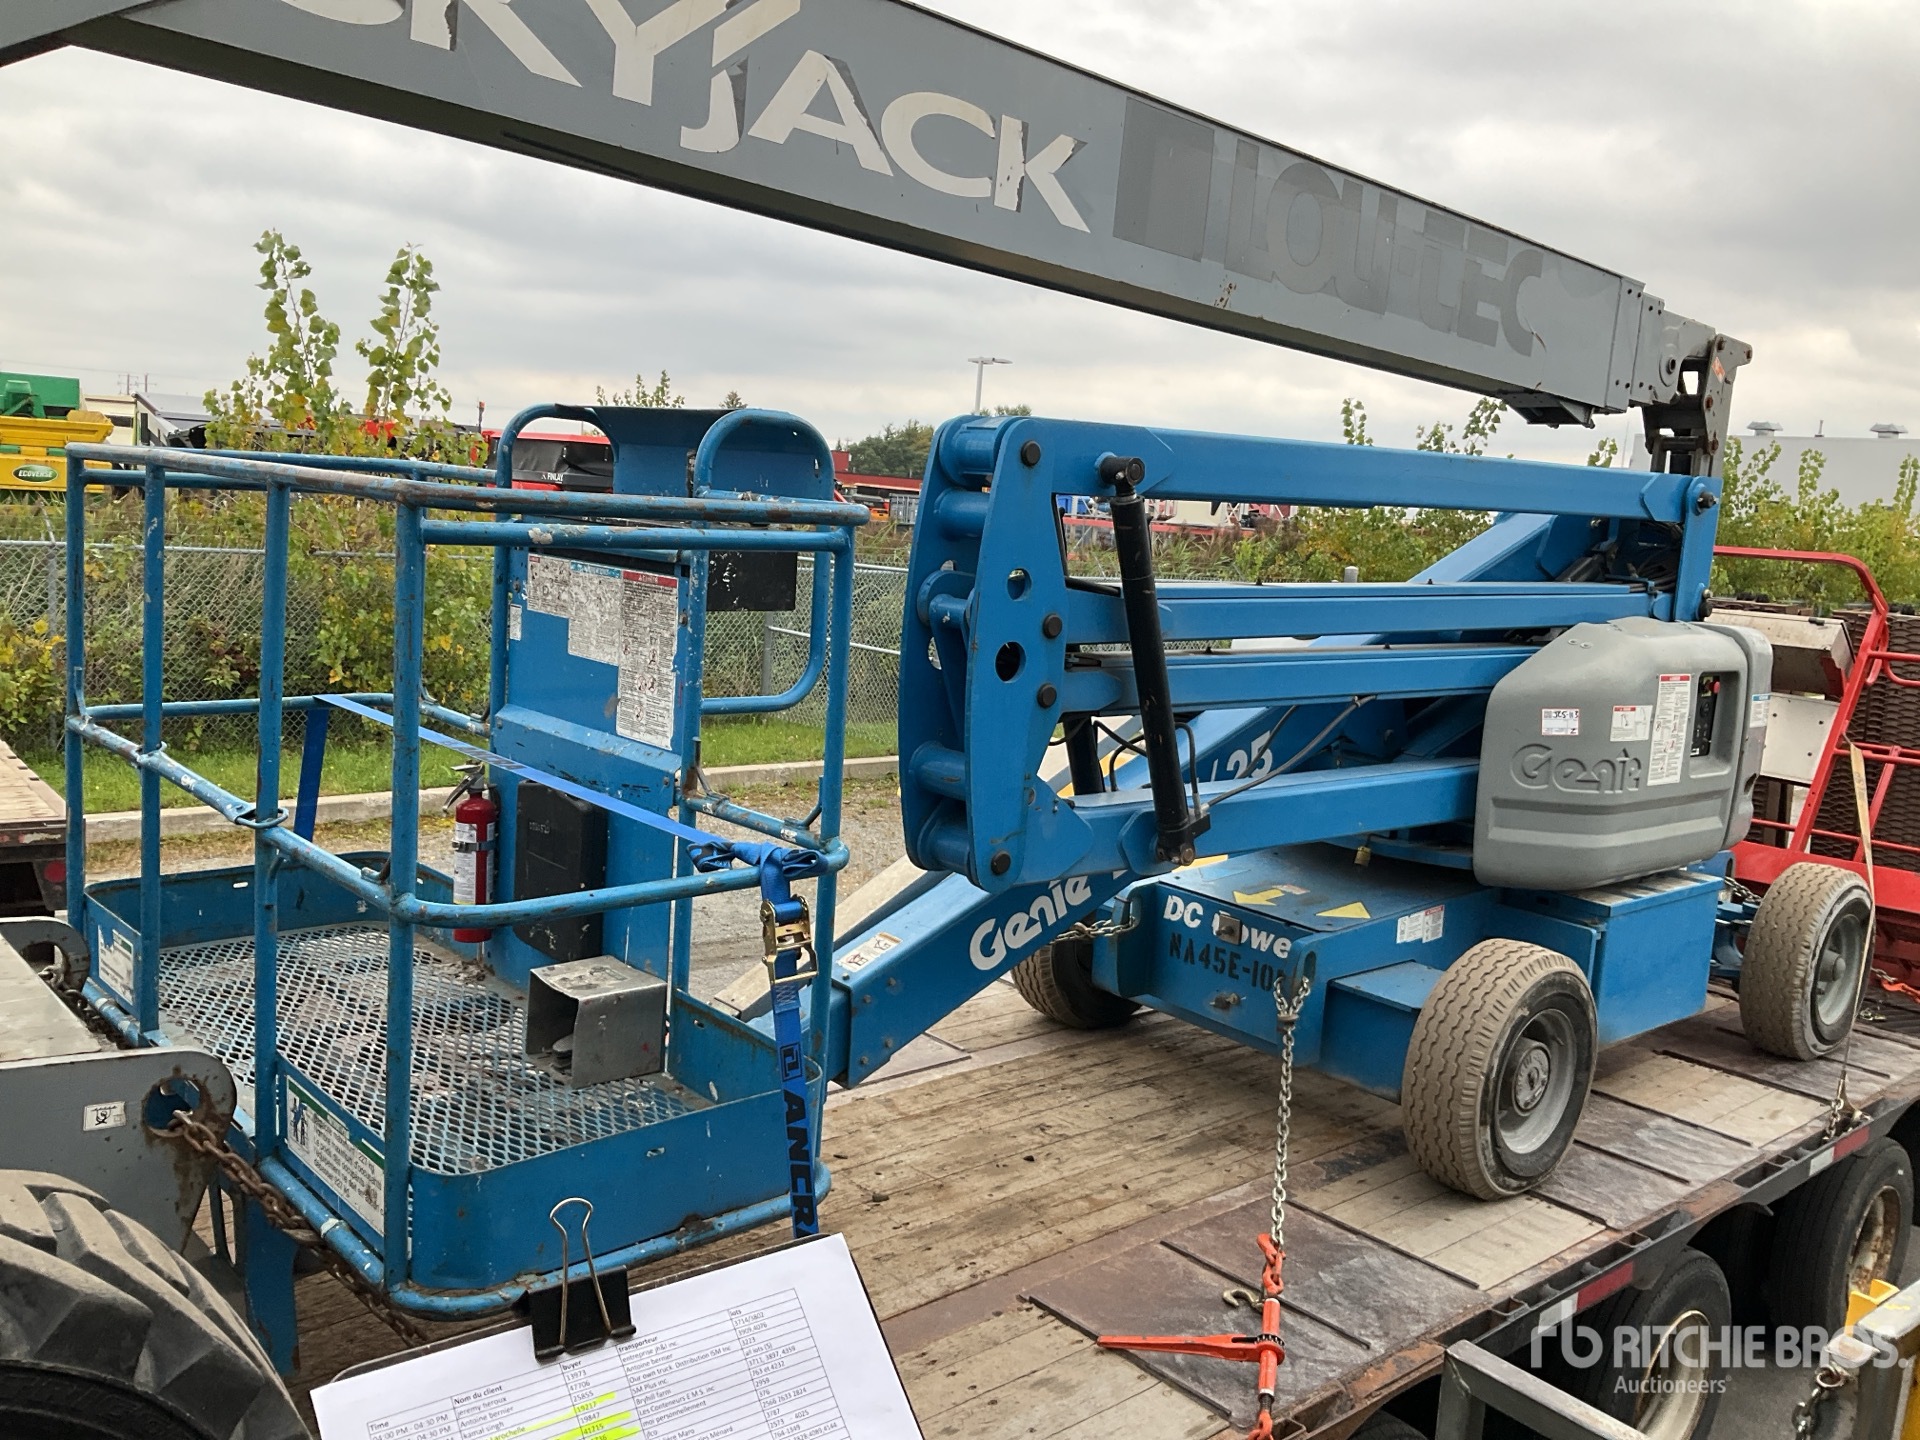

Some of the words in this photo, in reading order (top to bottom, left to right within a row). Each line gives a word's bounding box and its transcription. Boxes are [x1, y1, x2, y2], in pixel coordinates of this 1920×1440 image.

[18, 469, 53, 478] ECOVERSE
[547, 472, 564, 482] FINLAY
[1510, 743, 1644, 794] Genie
[1163, 895, 1204, 929] DC
[969, 875, 1092, 971] Genie
[618, 1337, 657, 1352] transporteur
[742, 1336, 755, 1345] 3223
[621, 1347, 653, 1362] entreprise
[562, 1359, 582, 1370] buyer
[625, 1360, 649, 1372] Antoine
[650, 1353, 672, 1364] bernier
[628, 1374, 640, 1383] Our
[642, 1370, 655, 1379] own
[674, 1352, 709, 1368] Distribution
[566, 1369, 586, 1380] 13973
[755, 1377, 769, 1387] 2959
[569, 1379, 590, 1391] 47706
[644, 1382, 656, 1390] Plus
[453, 1395, 471, 1405] Nom
[472, 1390, 482, 1399] du
[482, 1384, 502, 1396] client
[572, 1390, 593, 1402] 25855
[636, 1393, 655, 1405] Bryhill
[656, 1388, 671, 1397] farm
[639, 1407, 649, 1415] Les
[650, 1396, 685, 1412] Conteneurs
[655, 1400, 706, 1423] personnellement
[395, 1426, 408, 1435] PM
[435, 1413, 448, 1423] PM
[459, 1413, 487, 1428] Antoine
[488, 1405, 513, 1418] bernier
[369, 1419, 389, 1431] Time
[438, 1425, 451, 1434] PM
[462, 1426, 484, 1439] kamal
[485, 1420, 504, 1431] singh
